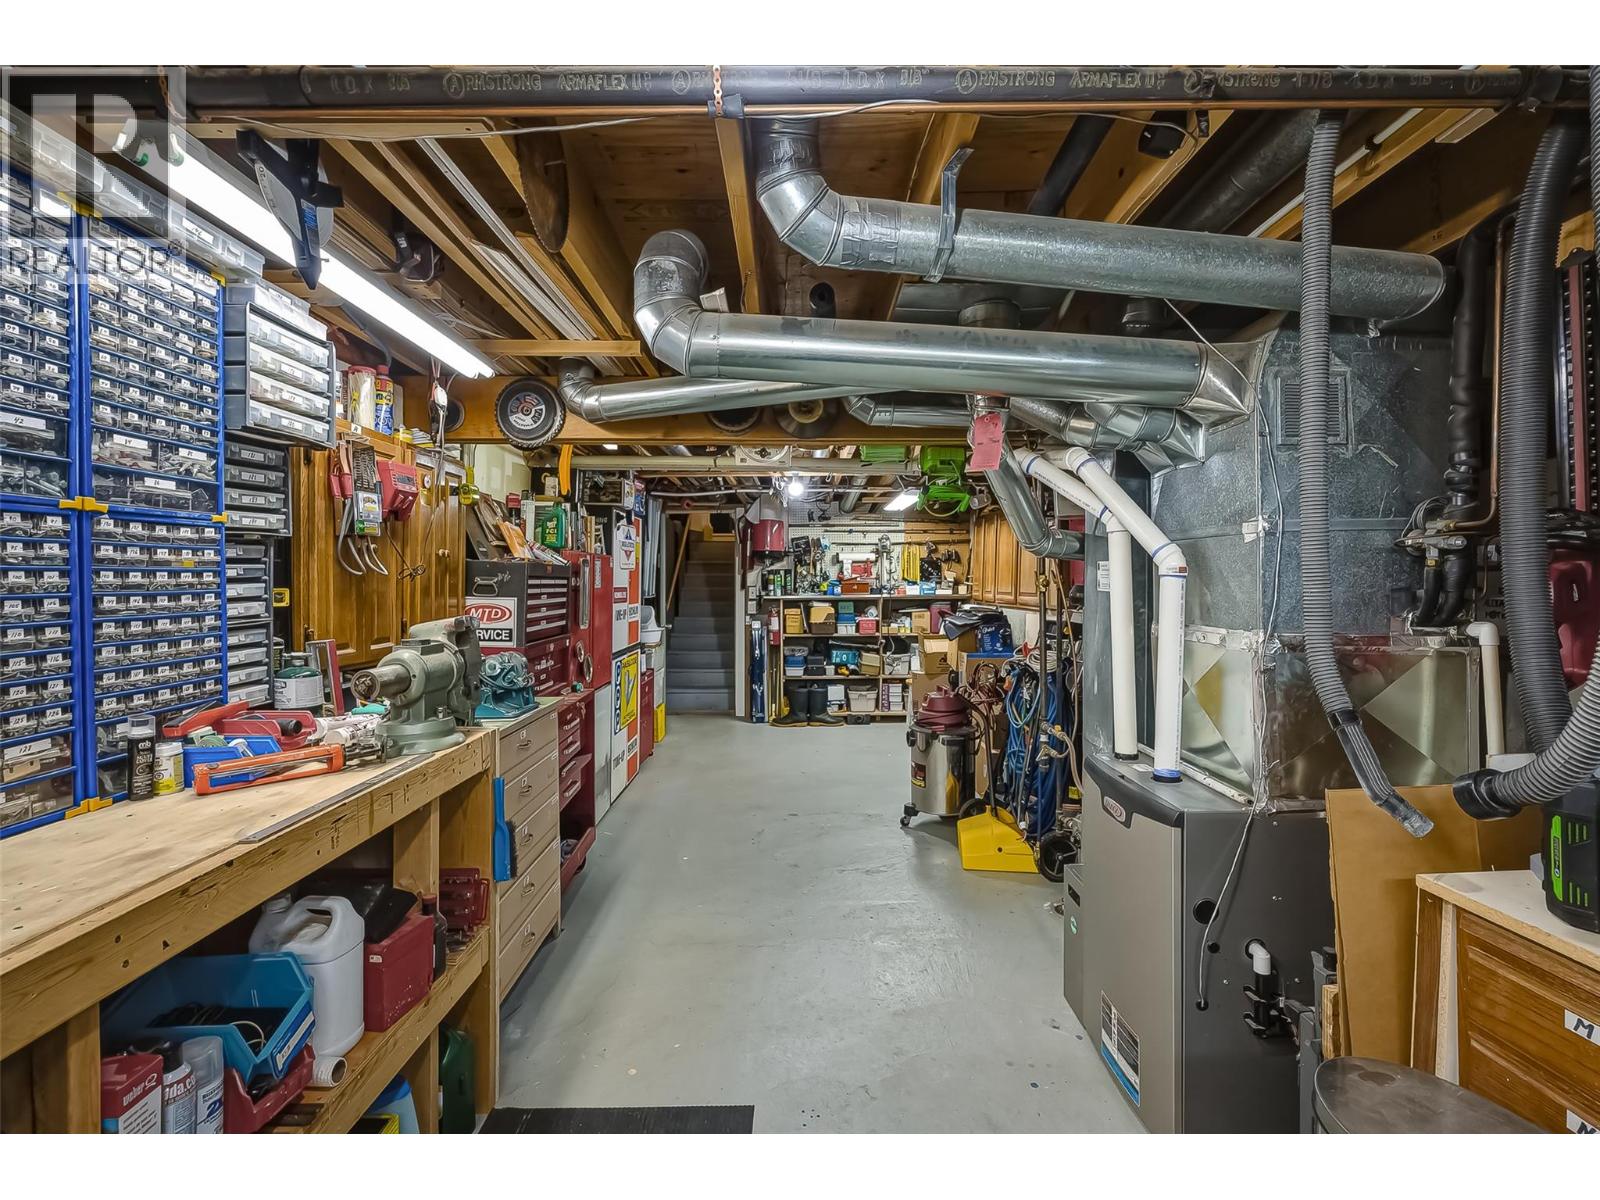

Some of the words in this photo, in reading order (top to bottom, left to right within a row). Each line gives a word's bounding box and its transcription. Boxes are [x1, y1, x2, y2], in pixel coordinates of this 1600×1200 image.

[443, 72, 541, 99] ARMSTRONG
[558, 73, 628, 91] ARMAFLEX
[956, 69, 1056, 95] ARMSTRONG
[1069, 71, 1141, 88] ARMAFLEX
[13, 416, 25, 425] 42
[469, 608, 502, 622] MTD
[475, 630, 511, 640] RVICE
[1572, 1017, 1594, 1040] M
[122, 1082, 146, 1107] weber
